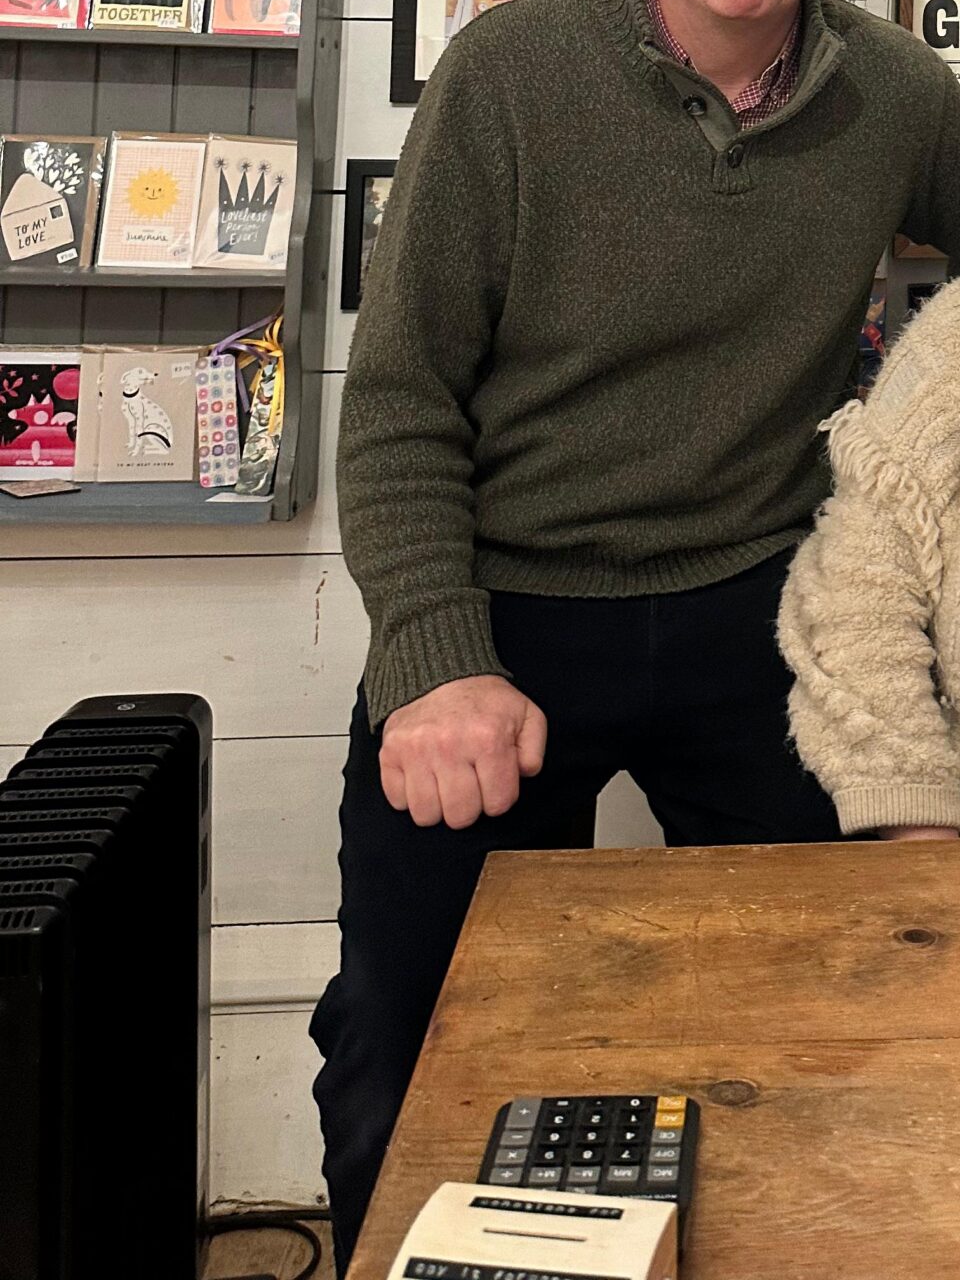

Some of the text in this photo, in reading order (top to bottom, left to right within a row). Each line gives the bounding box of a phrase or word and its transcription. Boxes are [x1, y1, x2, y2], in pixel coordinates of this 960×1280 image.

[97, 7, 183, 22] TOGETHER
[15, 217, 47, 236] TO MY
[18, 231, 46, 249] LOVE
[630, 1098, 640, 1107] 0
[553, 1115, 564, 1124] 3
[591, 1115, 601, 1123] 2
